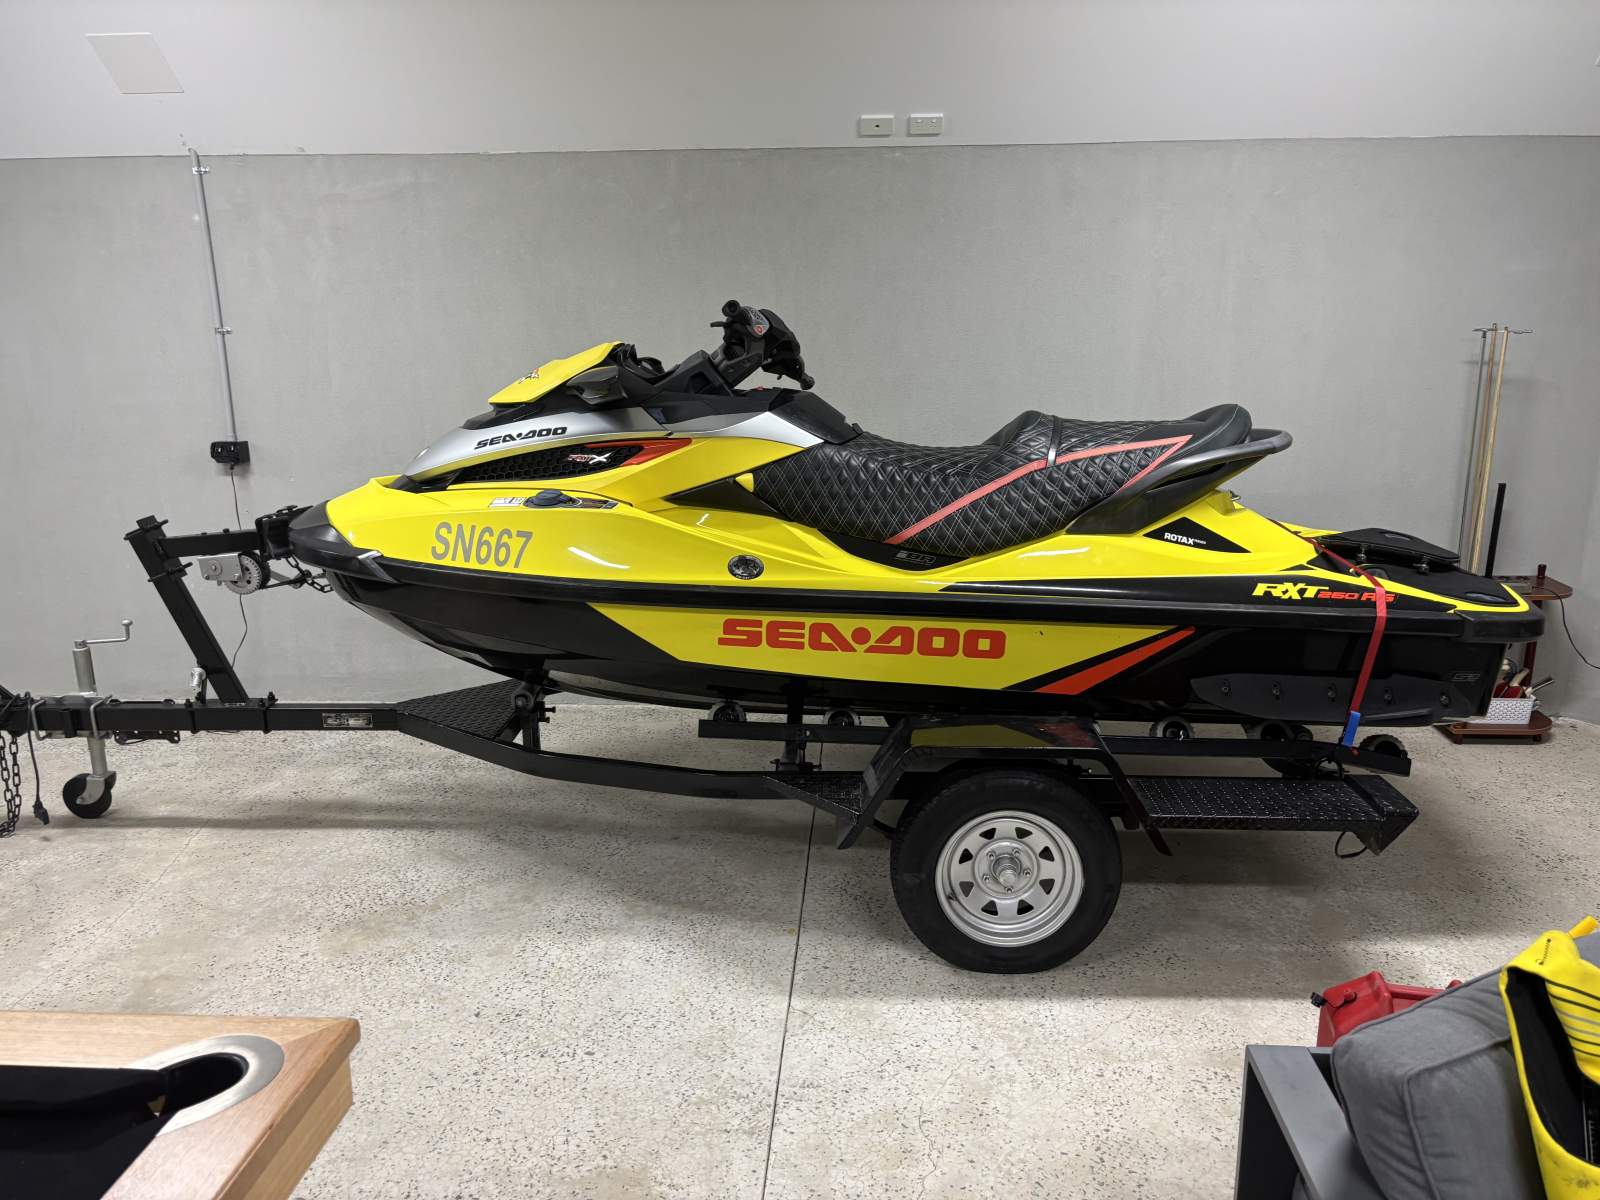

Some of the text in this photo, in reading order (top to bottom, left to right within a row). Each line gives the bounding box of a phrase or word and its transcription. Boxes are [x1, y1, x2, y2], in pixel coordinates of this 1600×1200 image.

[431, 521, 534, 569] SN667
[1164, 532, 1194, 545] ROTAX
[1252, 582, 1329, 600] RXT
[1317, 591, 1360, 600] 260
